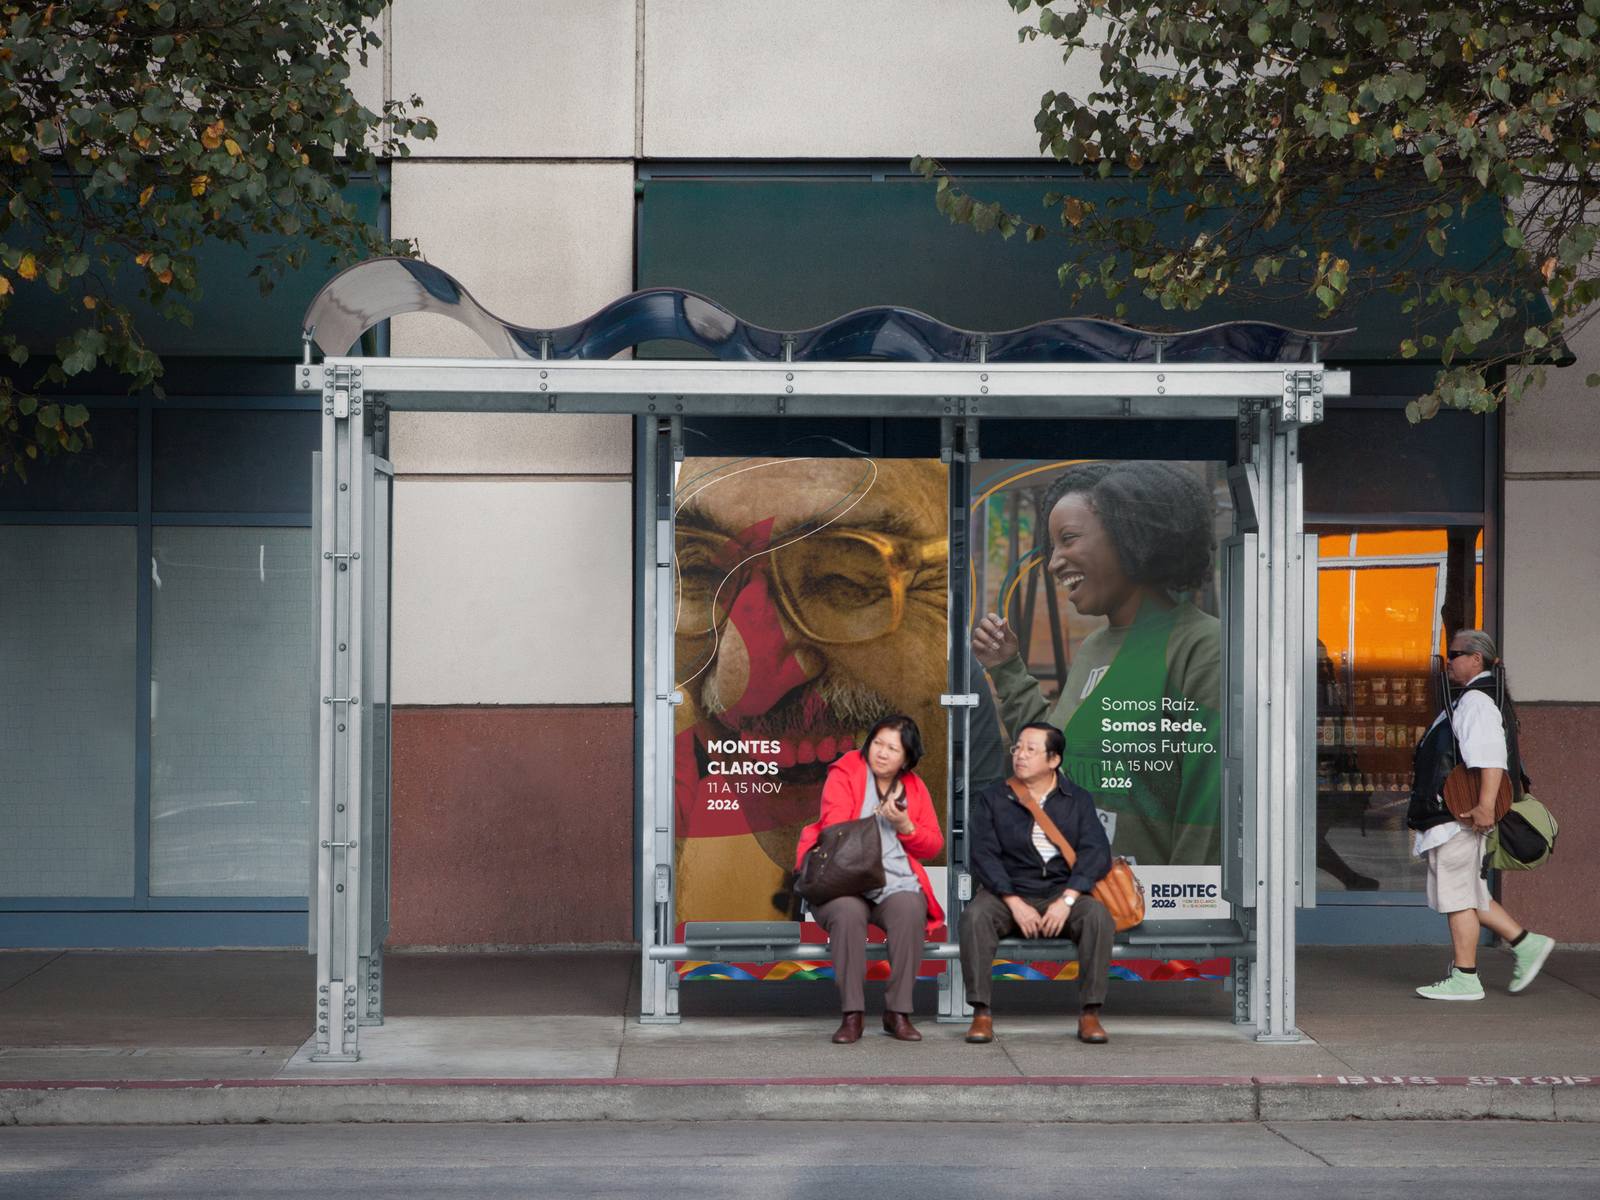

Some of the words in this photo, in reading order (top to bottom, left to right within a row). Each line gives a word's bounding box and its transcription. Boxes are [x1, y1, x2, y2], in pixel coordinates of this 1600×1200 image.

[1101, 697, 1157, 711] Somos
[1161, 697, 1199, 711] Raíz.
[1101, 718, 1157, 732] Somos
[1160, 718, 1207, 732] Rede.
[707, 740, 781, 754] MONTES
[1101, 739, 1157, 753] Somos
[1161, 739, 1217, 753] Futuro.
[707, 761, 779, 775] CLAROS
[1101, 760, 1111, 771] 11
[1115, 760, 1125, 771] A
[1127, 760, 1141, 771] 15
[1144, 760, 1174, 771] NOV
[707, 782, 718, 793] 11
[721, 782, 732, 793] A
[734, 782, 748, 793] 15
[752, 782, 782, 793] NOV
[1101, 777, 1133, 788] 2026
[707, 799, 740, 810] 2026
[1151, 884, 1217, 897] REDITEC
[1151, 899, 1176, 908] 2026
[1336, 1076, 1439, 1085] BUS
[1468, 1076, 1592, 1085] STOP
